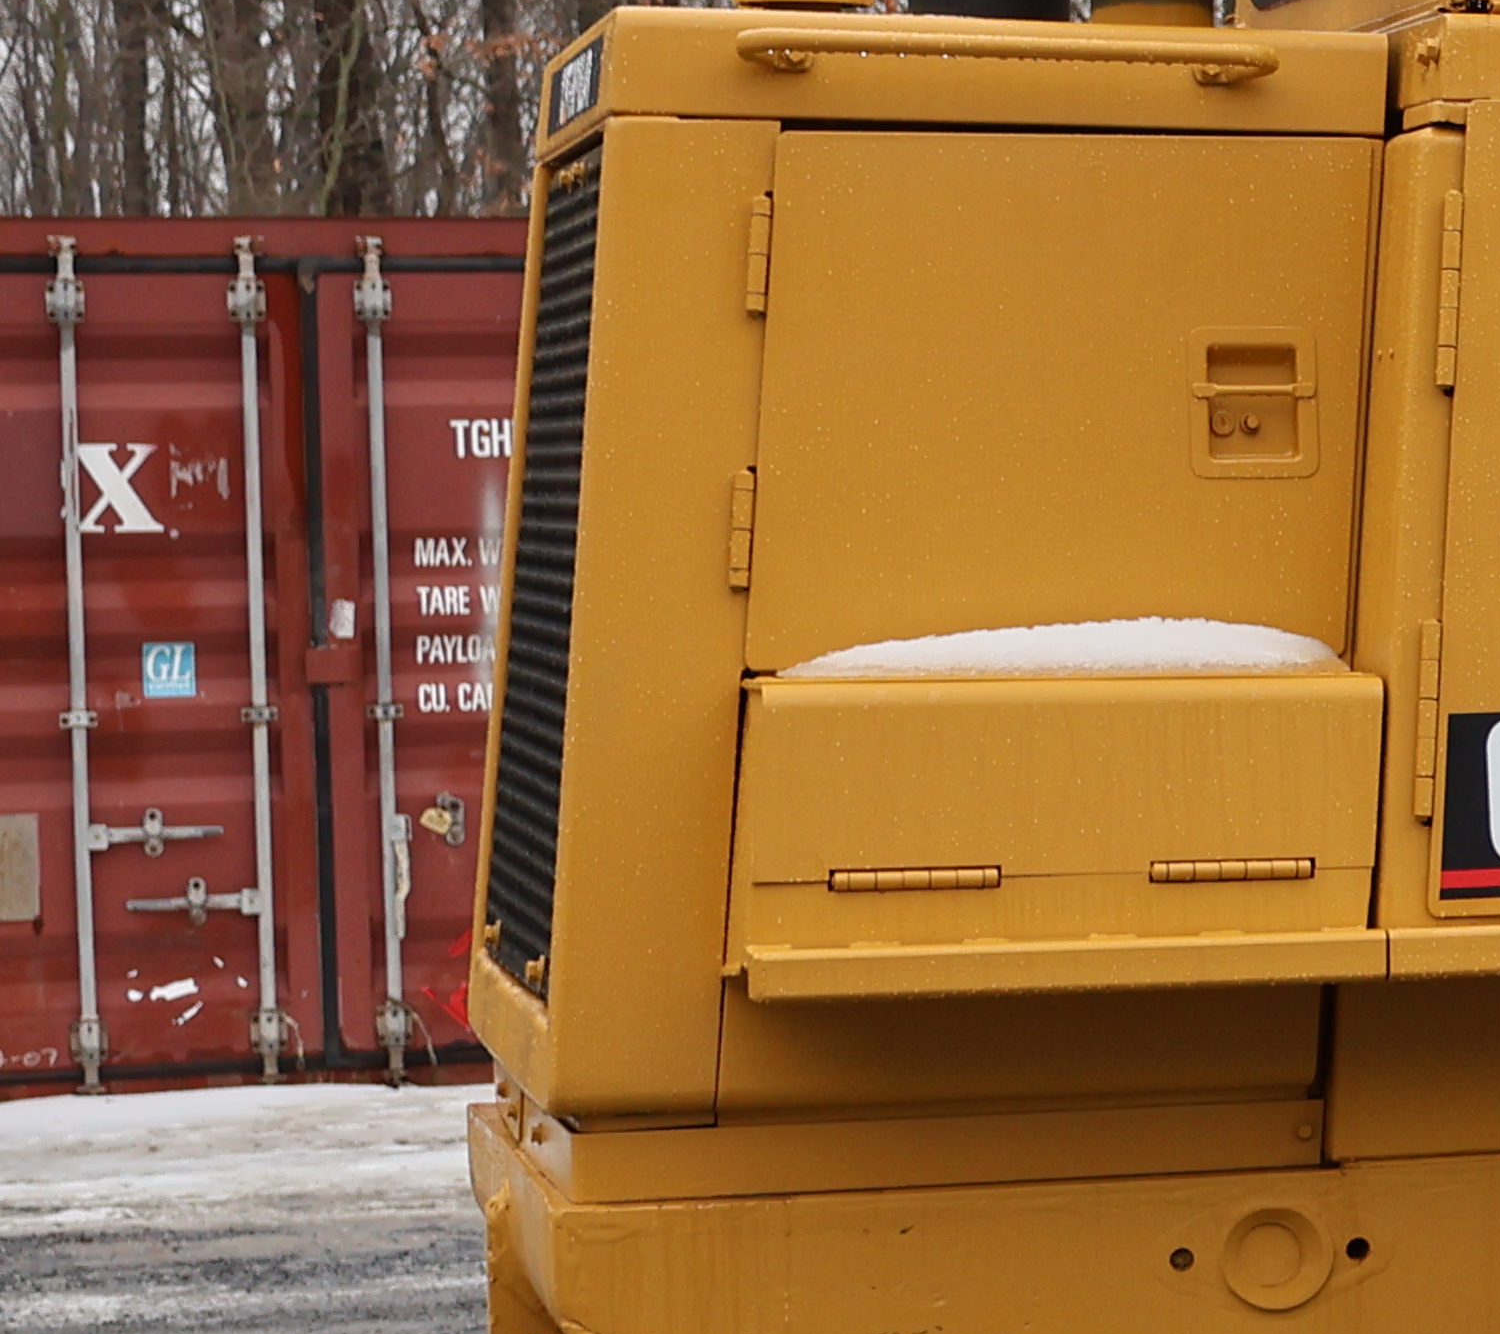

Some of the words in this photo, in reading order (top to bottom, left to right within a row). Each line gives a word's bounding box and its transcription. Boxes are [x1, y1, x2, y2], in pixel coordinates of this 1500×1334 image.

[414, 536, 474, 567] MAX.
[416, 585, 471, 617] TARE
[147, 645, 191, 681] GL
[418, 682, 450, 713] CU.
